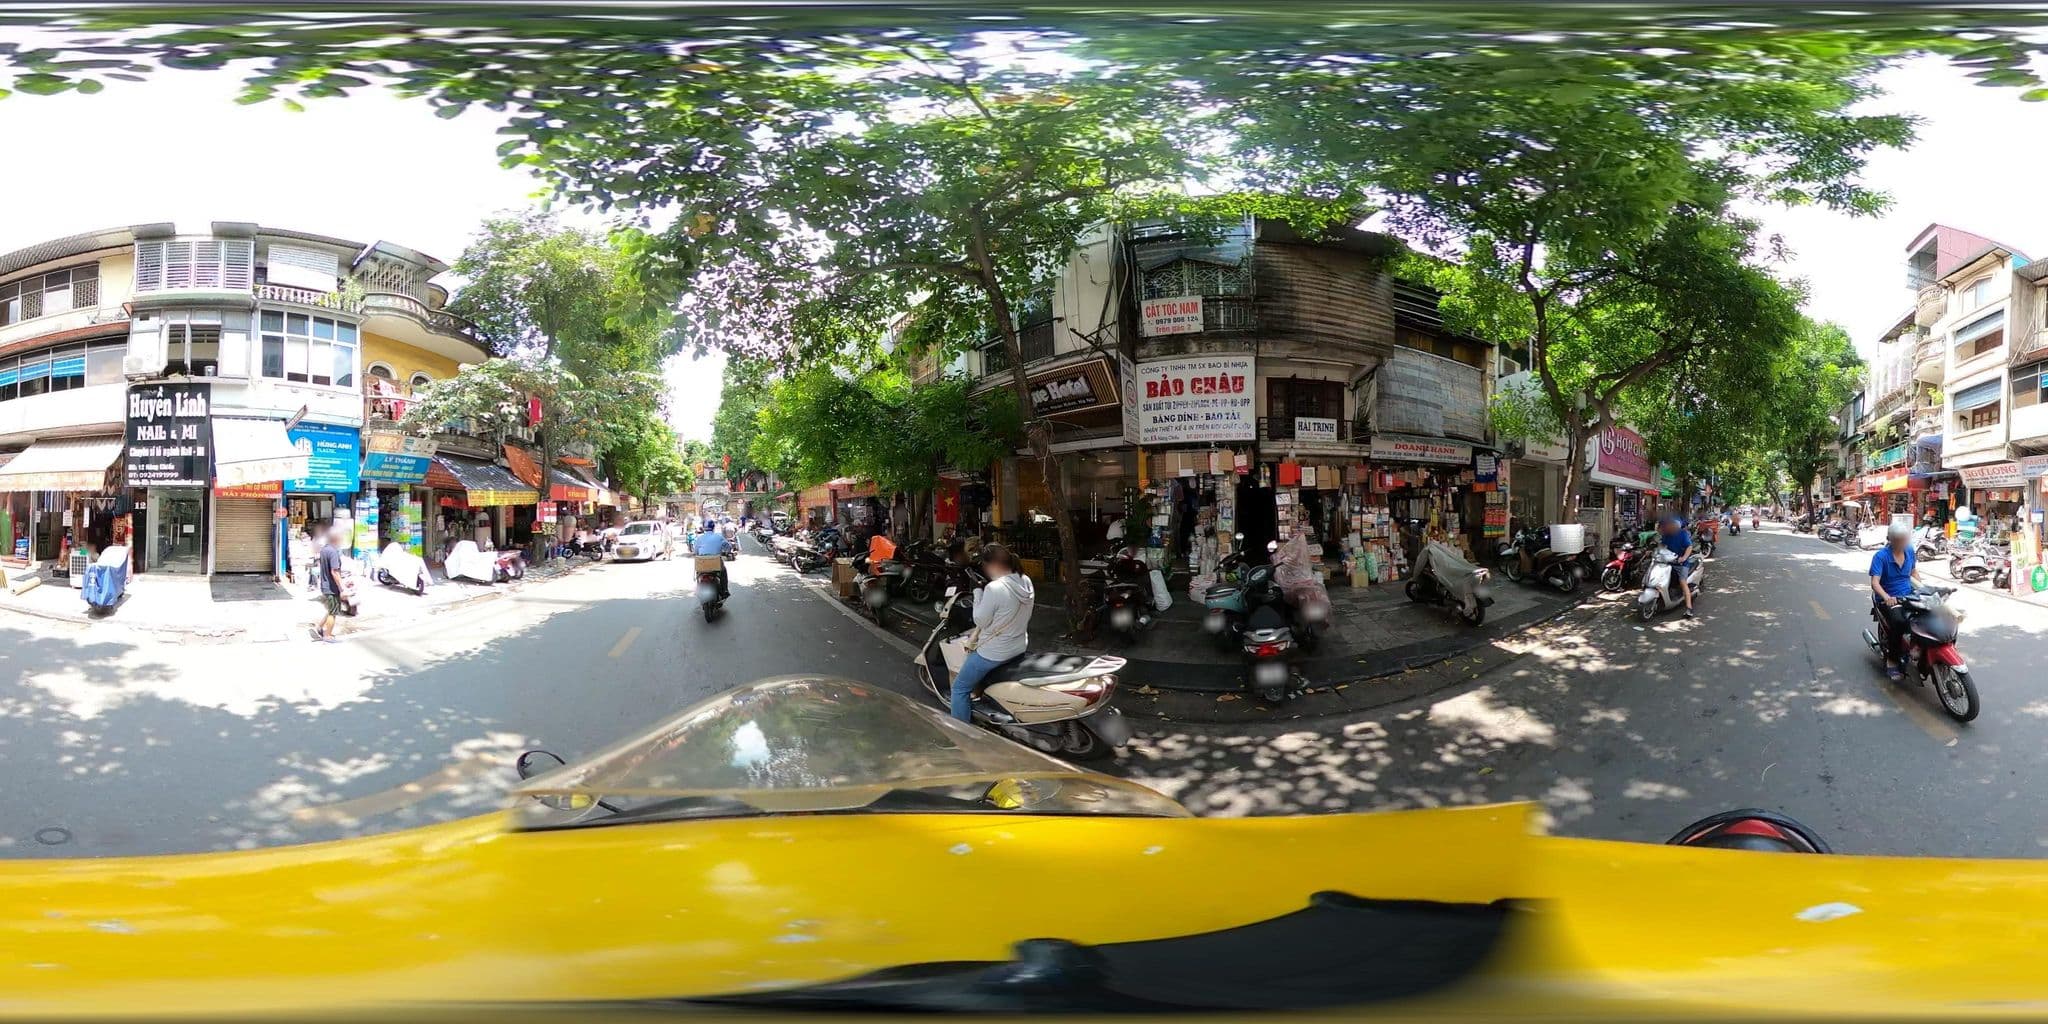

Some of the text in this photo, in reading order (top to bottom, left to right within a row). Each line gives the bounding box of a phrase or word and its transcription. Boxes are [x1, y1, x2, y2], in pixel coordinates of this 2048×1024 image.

[1180, 302, 1199, 315] NAM
[1046, 376, 1090, 400] Hotel
[1146, 372, 1244, 398] BẢO CHÂU
[1987, 465, 2017, 476] LONG
[134, 502, 147, 510] 12
